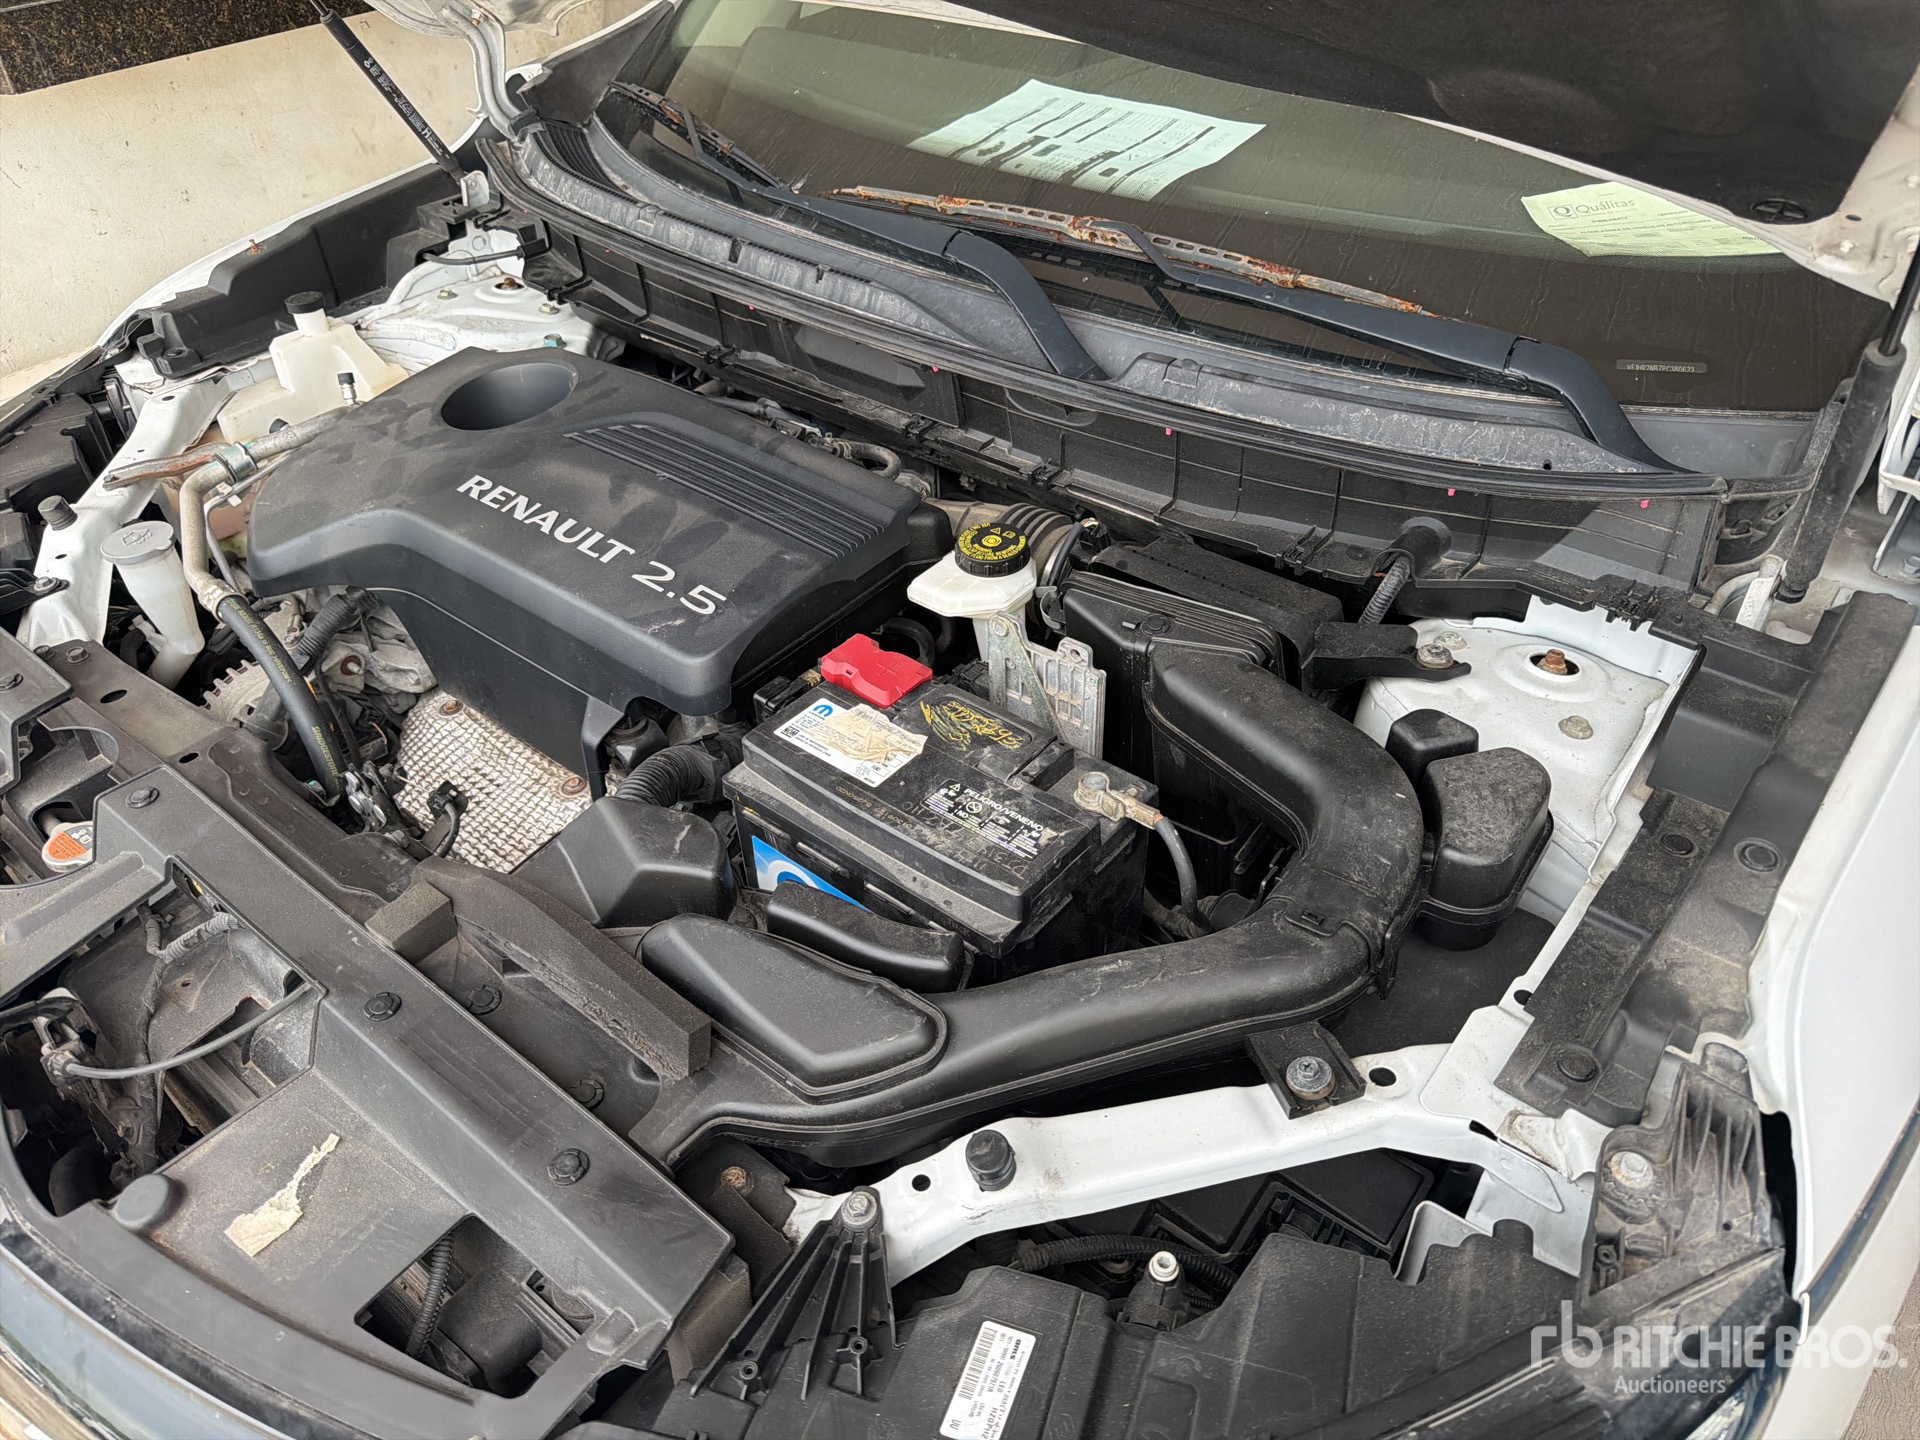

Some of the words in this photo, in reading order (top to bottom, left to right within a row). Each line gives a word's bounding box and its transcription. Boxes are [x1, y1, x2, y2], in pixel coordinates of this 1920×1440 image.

[1575, 199, 1636, 213] Quálitas
[457, 474, 636, 564] RENAULT
[631, 560, 727, 615] 2.5
[311, 725, 339, 776] BRIDGESTONE
[963, 788, 1044, 831] PELIGRO/VENENO
[996, 1380, 1007, 1393] LED
